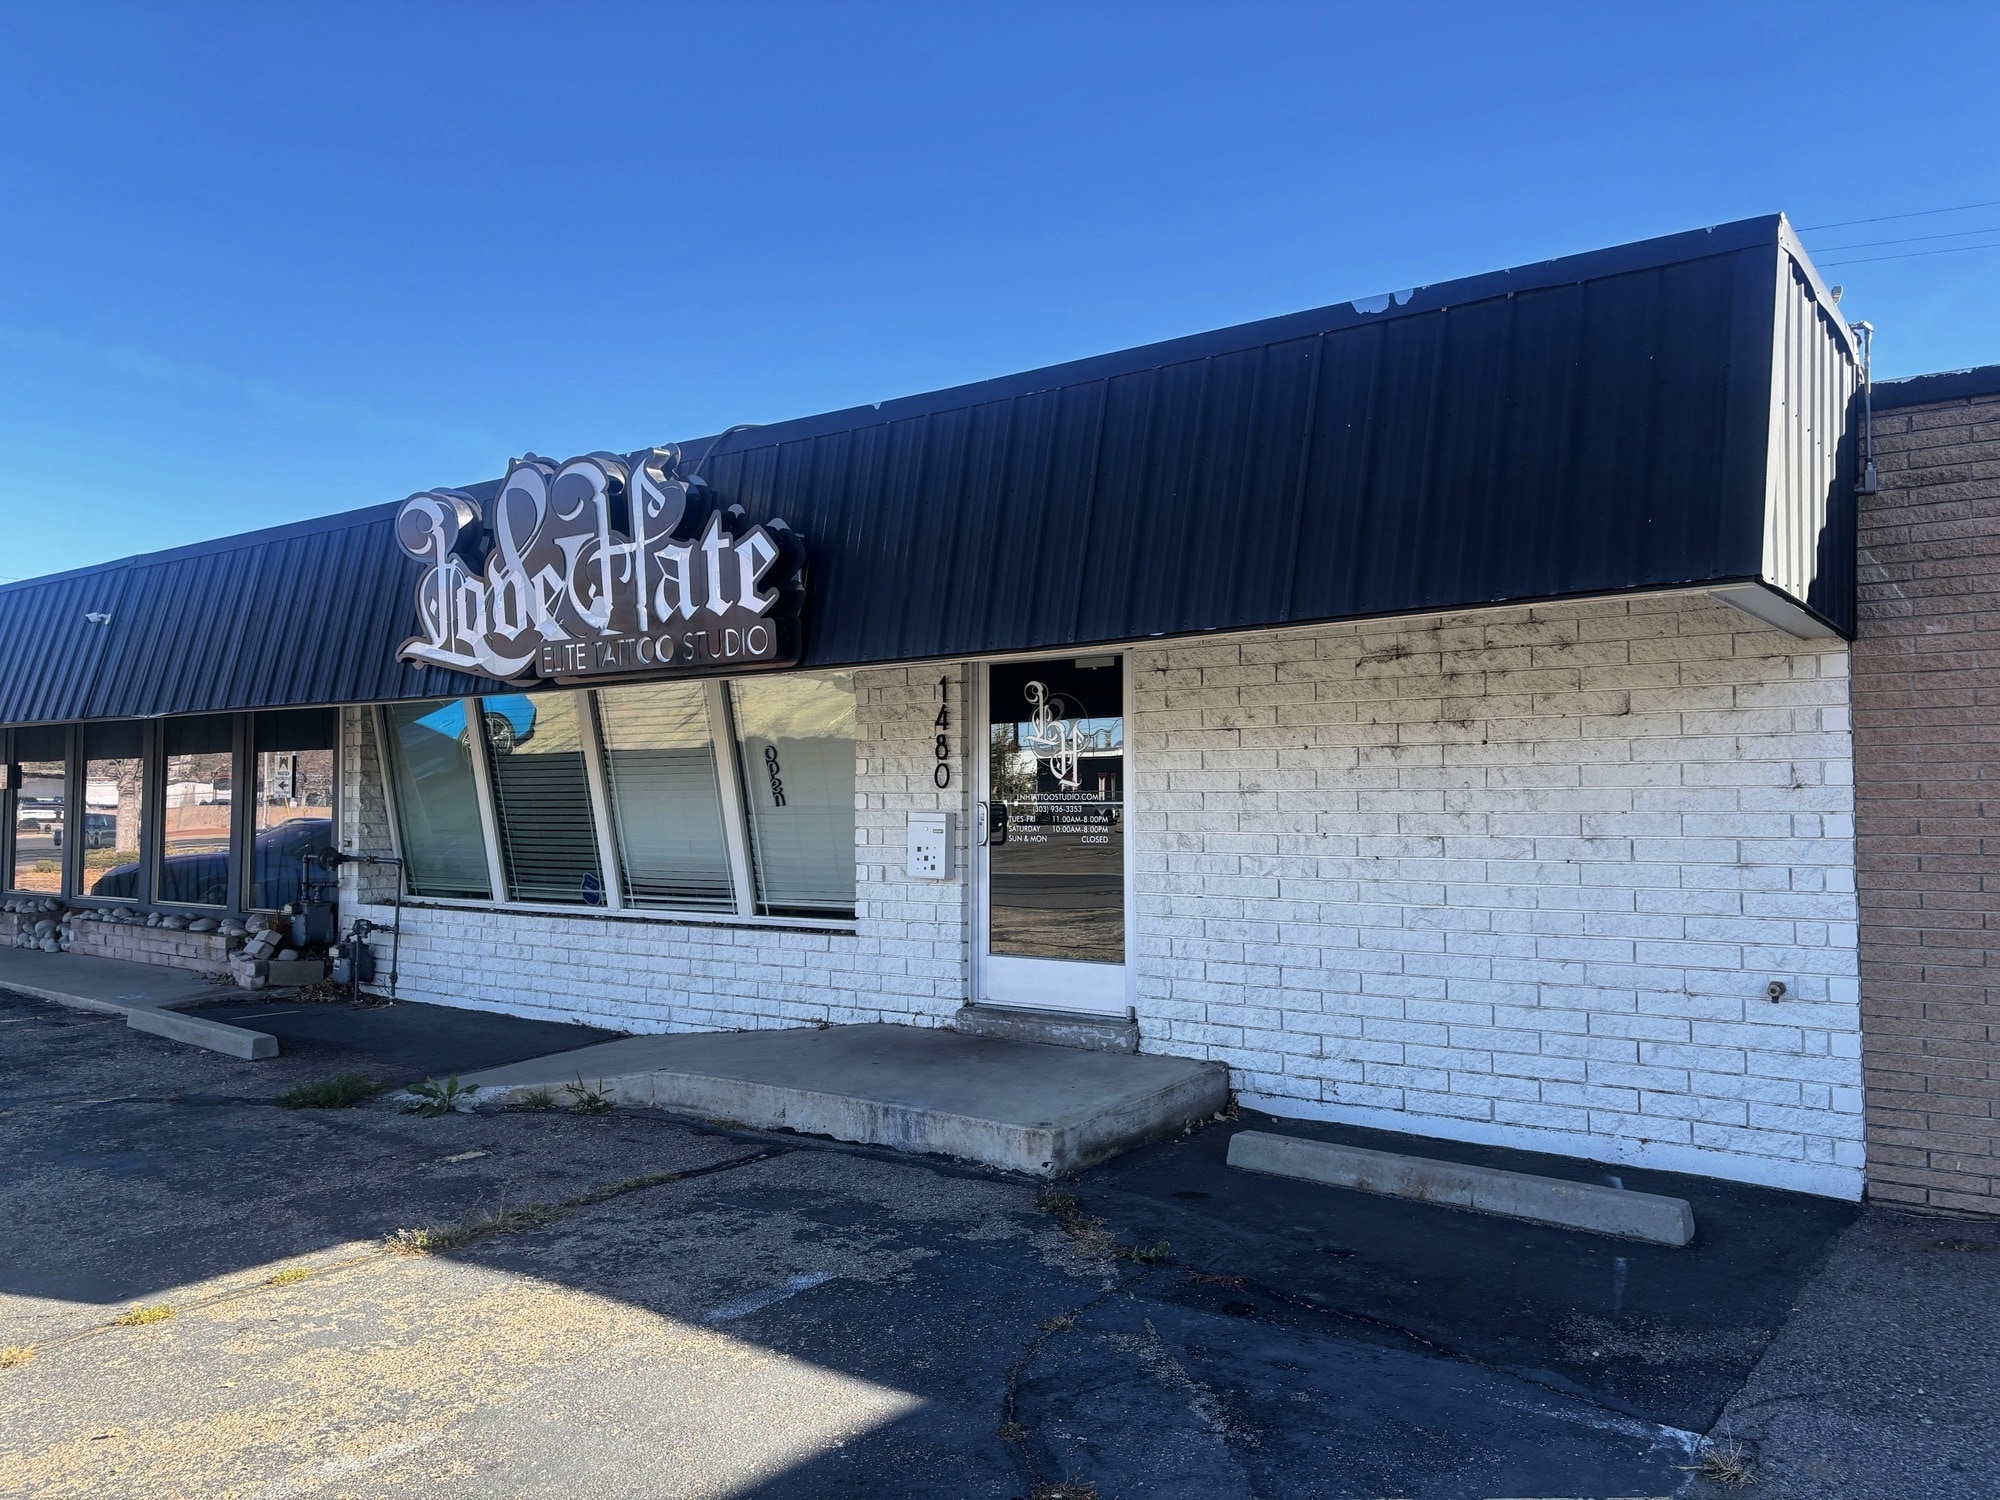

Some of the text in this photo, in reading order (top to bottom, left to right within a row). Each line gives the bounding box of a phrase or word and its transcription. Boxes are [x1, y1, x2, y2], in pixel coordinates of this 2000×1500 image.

[542, 625, 769, 673] ELITE TATTOO STUDIO
[934, 675, 951, 789] 1480
[1016, 793, 1099, 801] LNHTATTOOSTUDIO.COM
[1050, 805, 1082, 813] 936-3353
[1008, 815, 1036, 823] TUES-FRI
[1008, 825, 1041, 833] SATURDAY
[1008, 834, 1023, 842] SUN
[1030, 835, 1048, 843] MON
[1081, 835, 1109, 844] CLOSED
